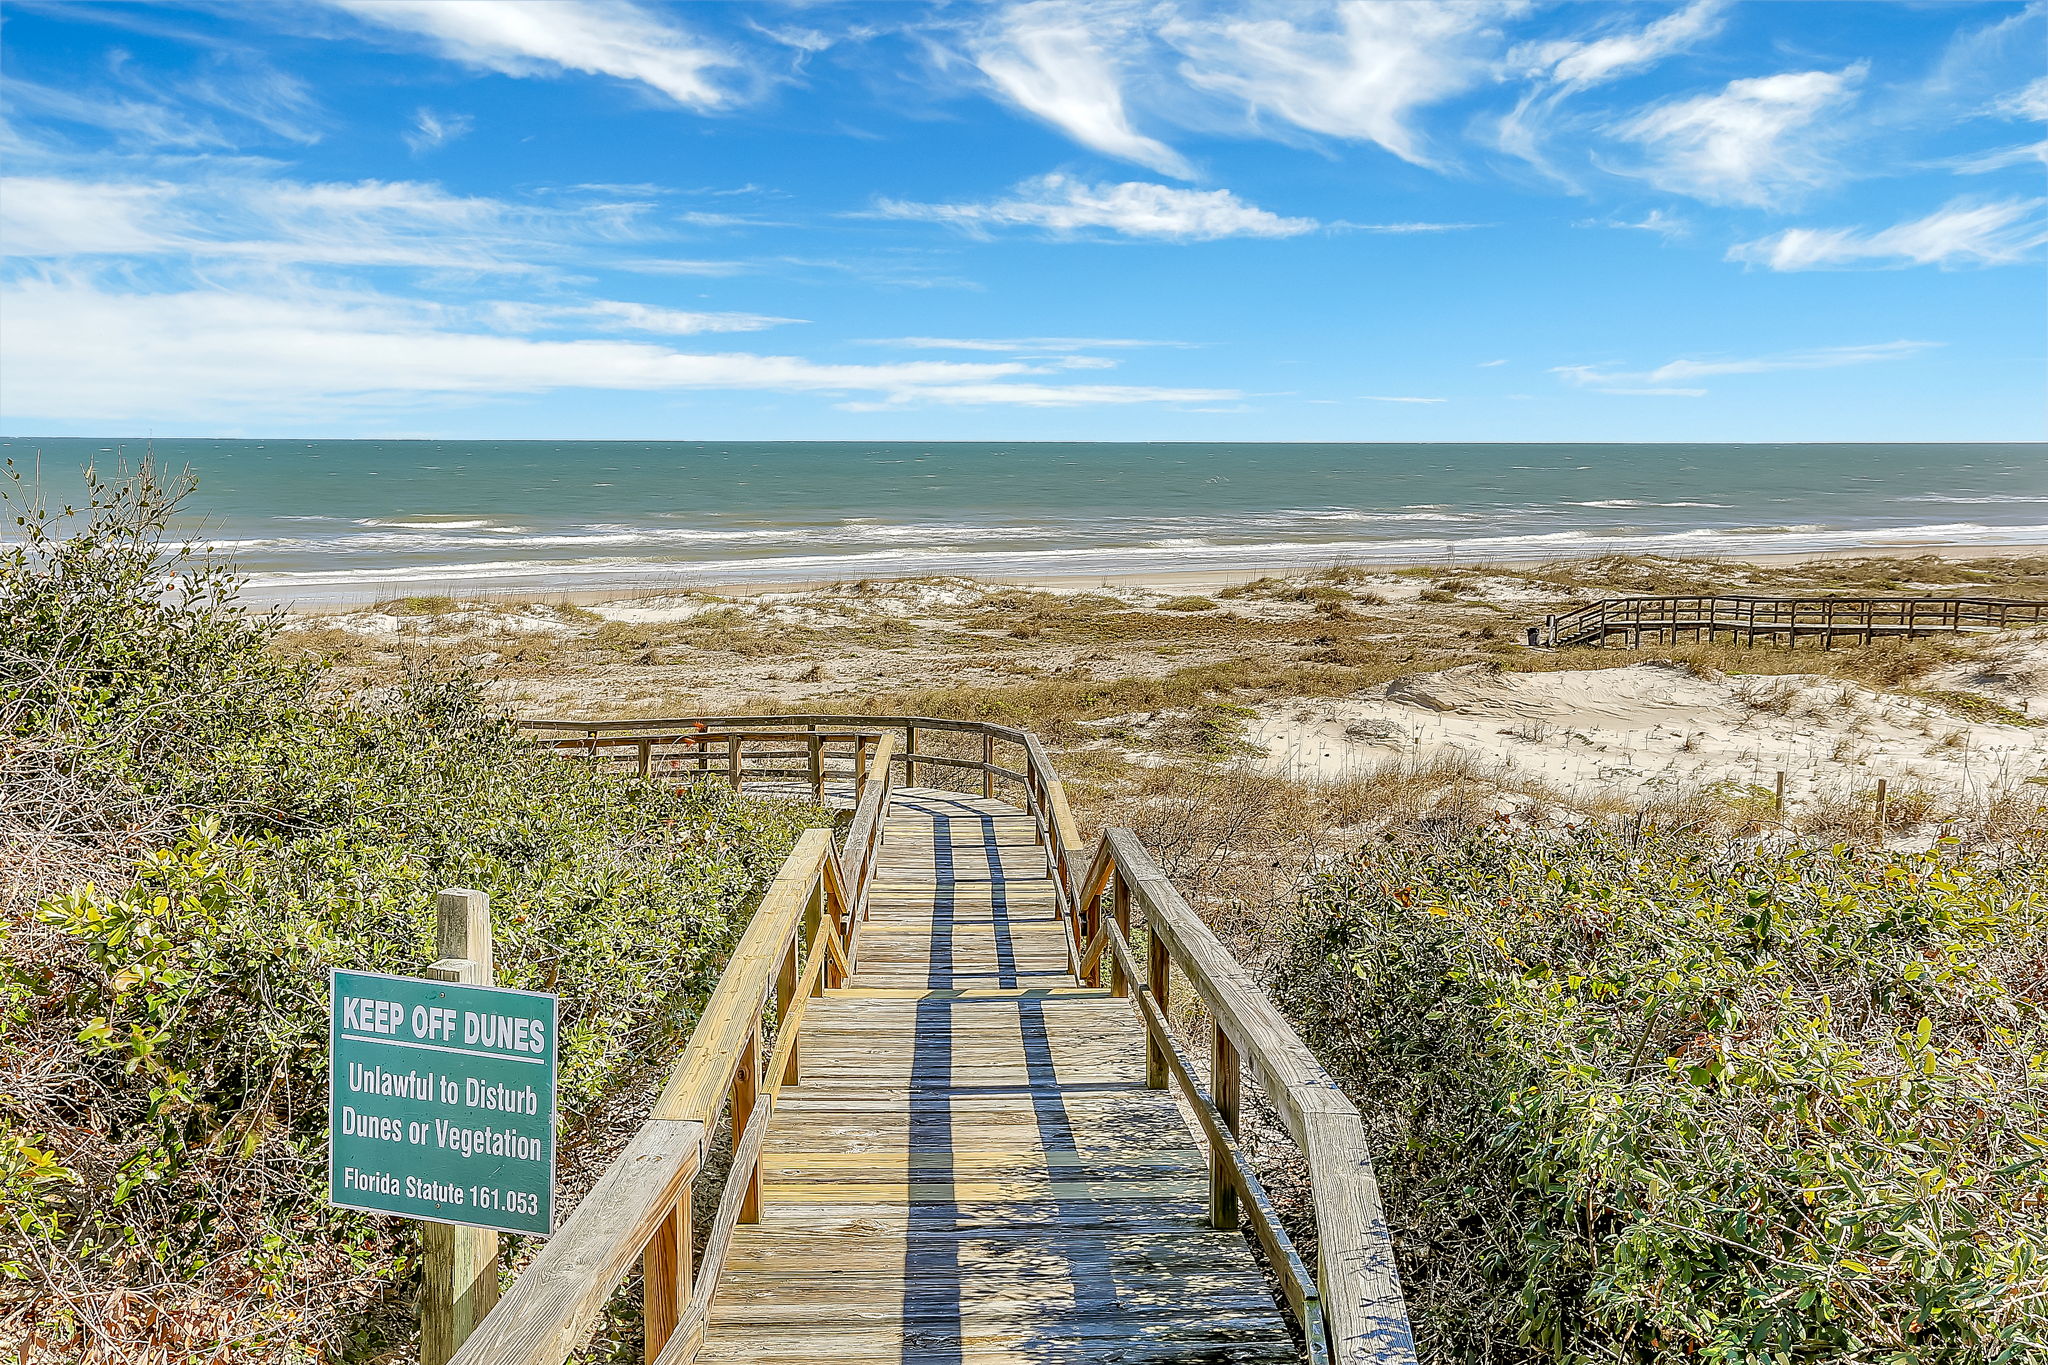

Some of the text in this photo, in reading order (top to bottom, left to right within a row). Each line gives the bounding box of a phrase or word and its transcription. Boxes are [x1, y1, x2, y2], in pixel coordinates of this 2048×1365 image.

[343, 996, 545, 1054] KEEP OFF DUNES
[349, 1062, 538, 1116] Unlawful to Disturb
[342, 1106, 541, 1161] Dunes or Vegetation
[344, 1167, 538, 1216] Florida Statute 161.053
